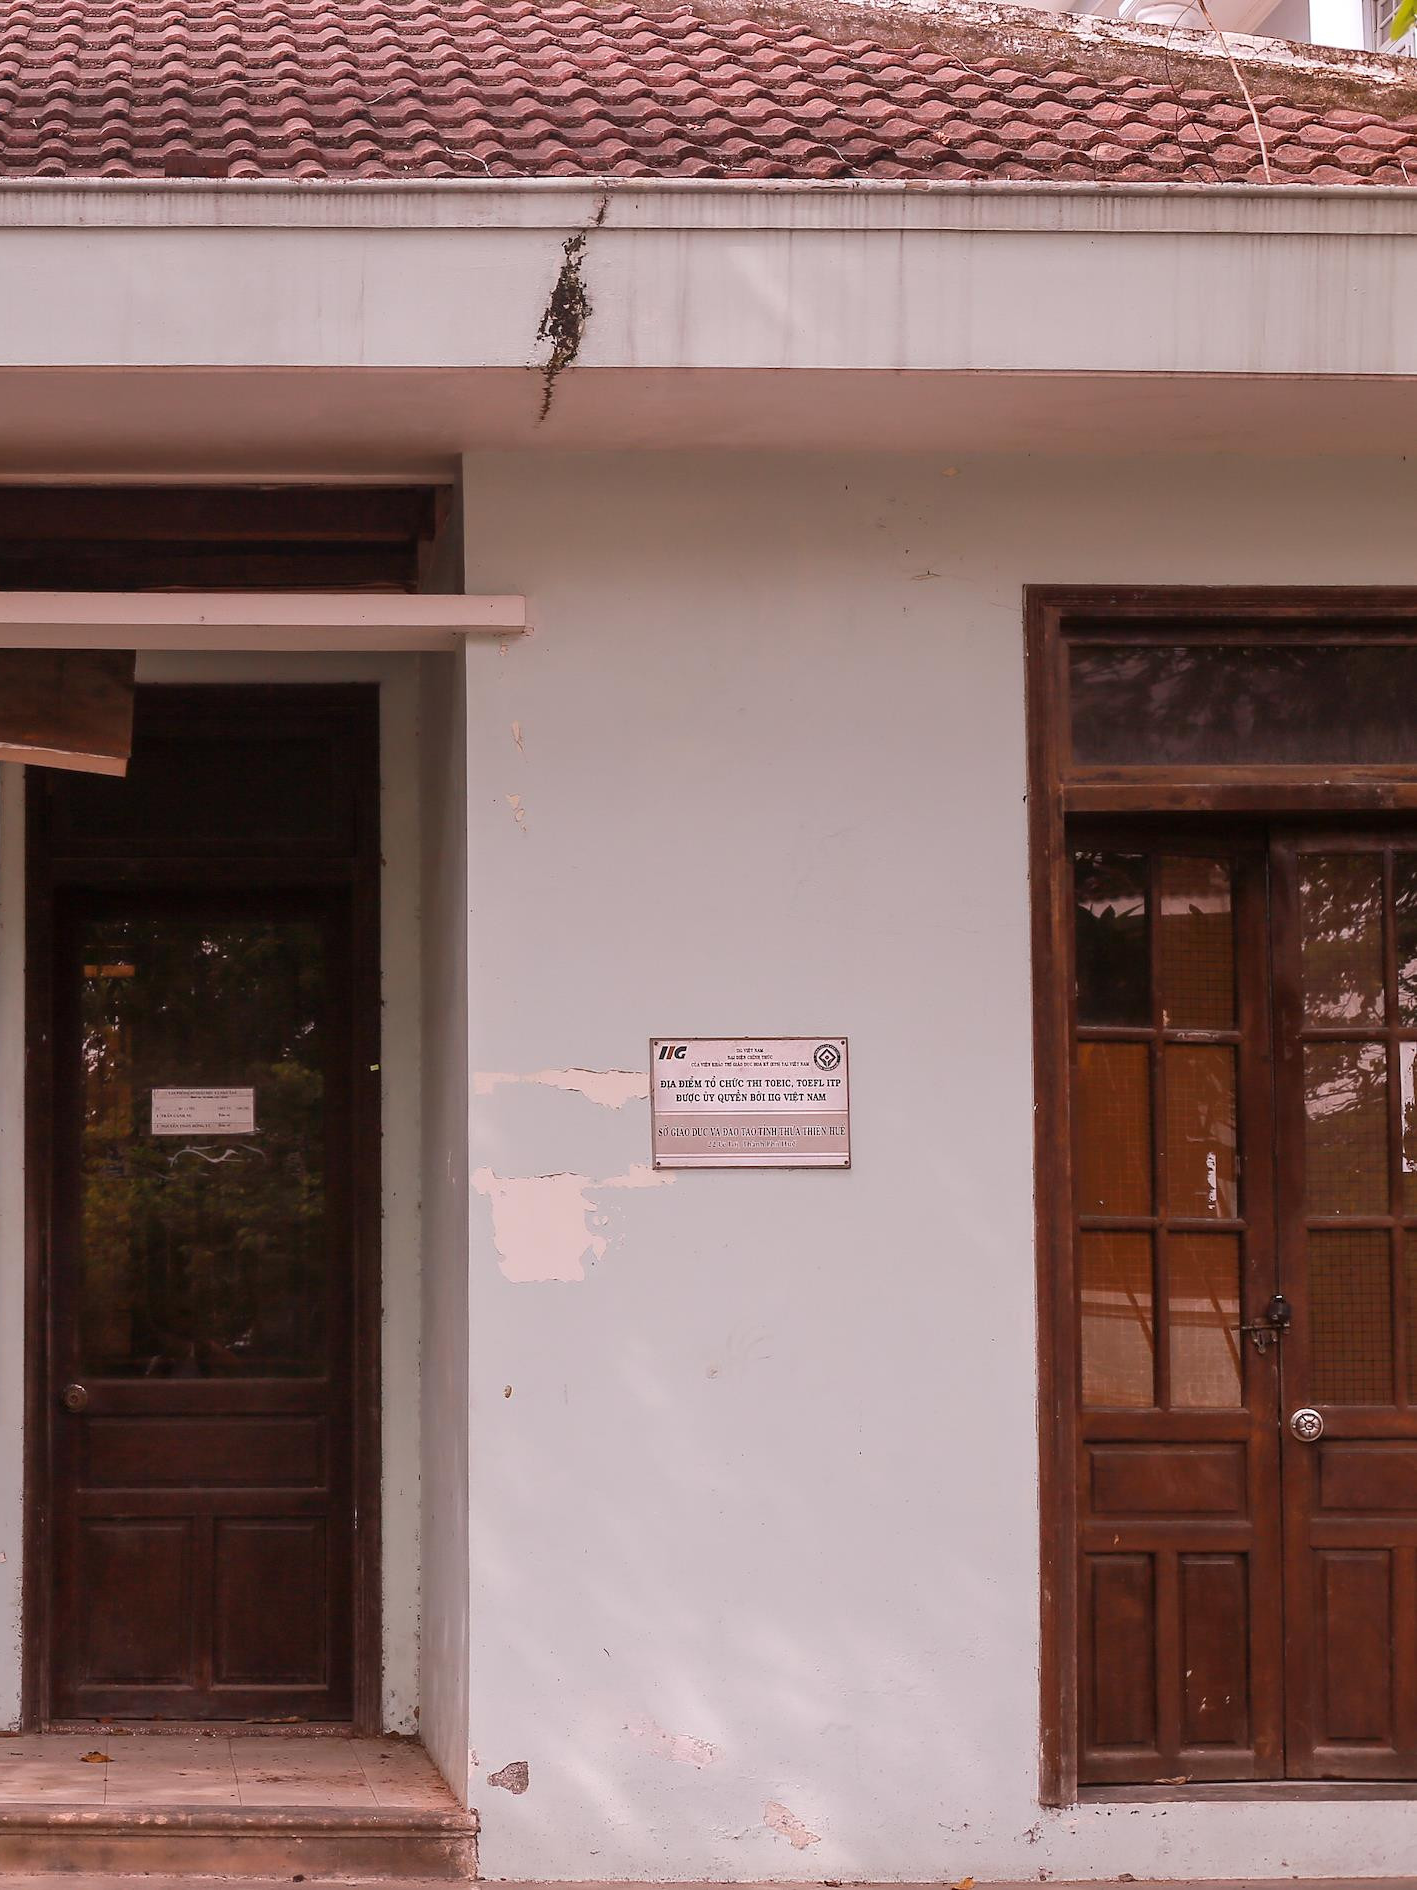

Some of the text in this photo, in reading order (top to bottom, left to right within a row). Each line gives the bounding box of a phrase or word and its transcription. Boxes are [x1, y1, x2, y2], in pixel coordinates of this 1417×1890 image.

[658, 1045, 687, 1060] IIG
[660, 1080, 676, 1090] ĐỊA
[678, 1076, 702, 1088] ĐIỂM
[719, 1078, 744, 1088] CHỨC
[747, 1079, 762, 1087] THI
[765, 1079, 794, 1088] TOEIC,
[796, 1079, 824, 1087] TOEFL
[826, 1079, 841, 1087] ITP
[676, 1092, 700, 1103] ĐƯỢC
[783, 1092, 804, 1103] VIỆT
[807, 1093, 826, 1101] NAM
